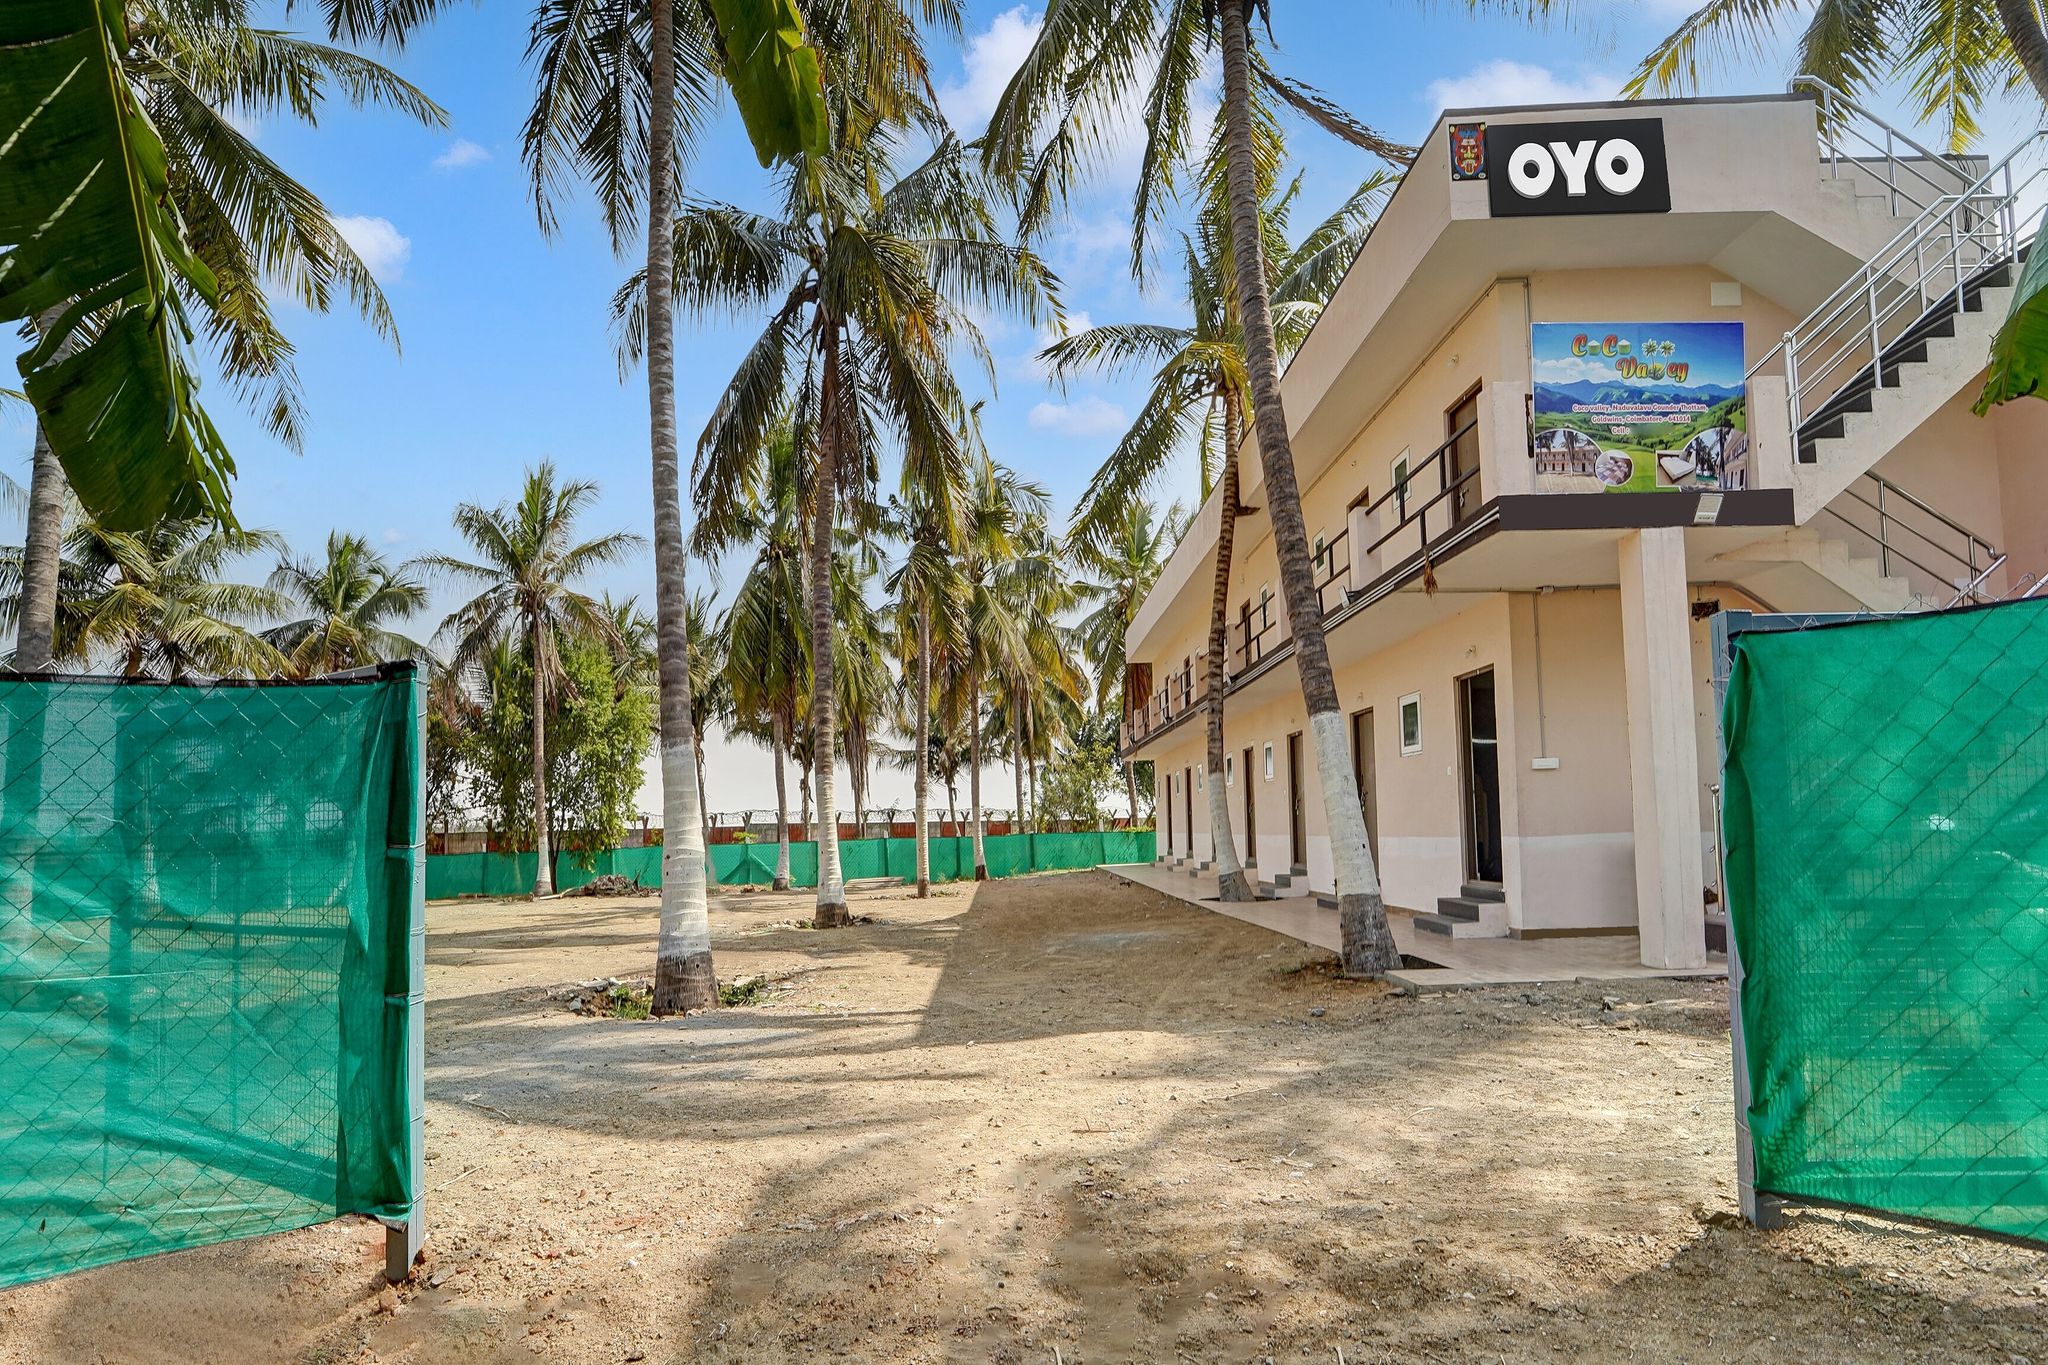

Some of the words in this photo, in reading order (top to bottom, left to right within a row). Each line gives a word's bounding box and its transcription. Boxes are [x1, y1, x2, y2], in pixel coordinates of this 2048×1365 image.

[1507, 138, 1645, 199] OYO
[1572, 404, 1589, 412] Coco
[1625, 415, 1662, 423] Coimbatore
